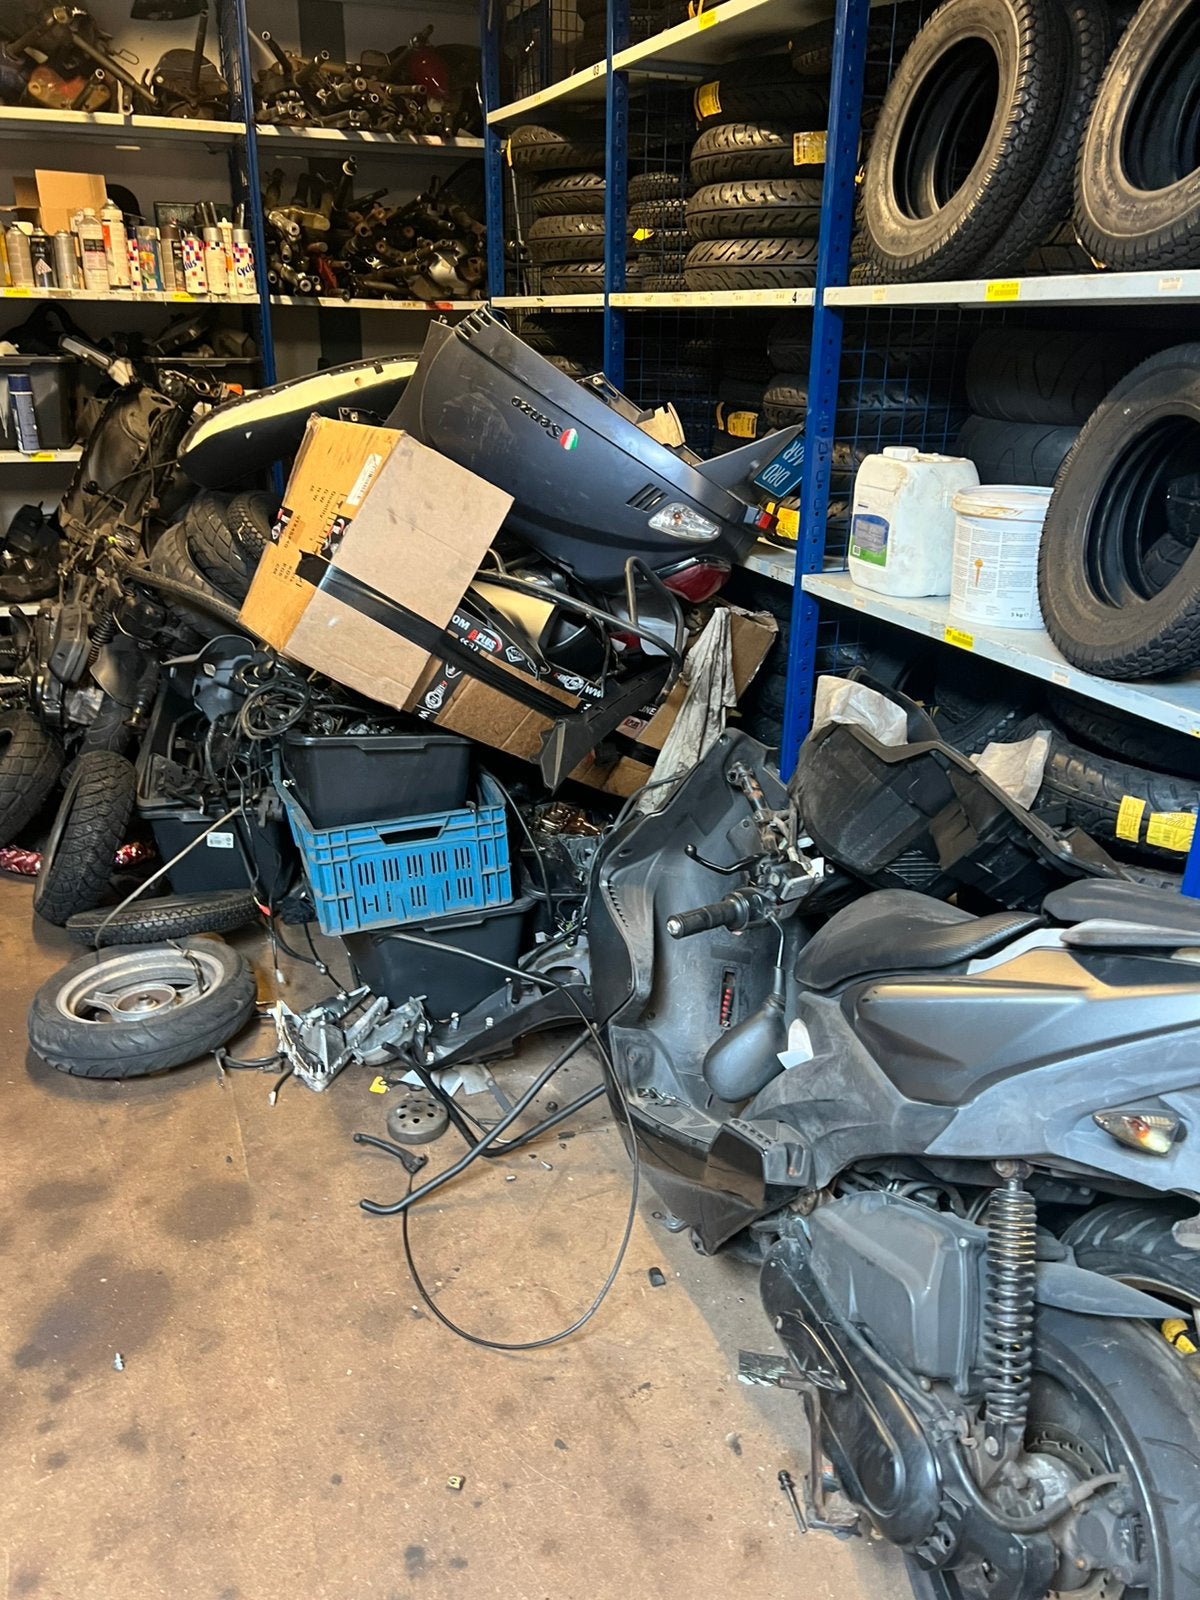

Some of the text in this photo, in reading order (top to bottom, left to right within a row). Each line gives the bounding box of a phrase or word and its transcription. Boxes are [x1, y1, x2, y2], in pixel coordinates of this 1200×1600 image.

[511, 396, 563, 440] Senzo
[761, 463, 791, 488] DRD
[467, 629, 498, 650] APLUS
